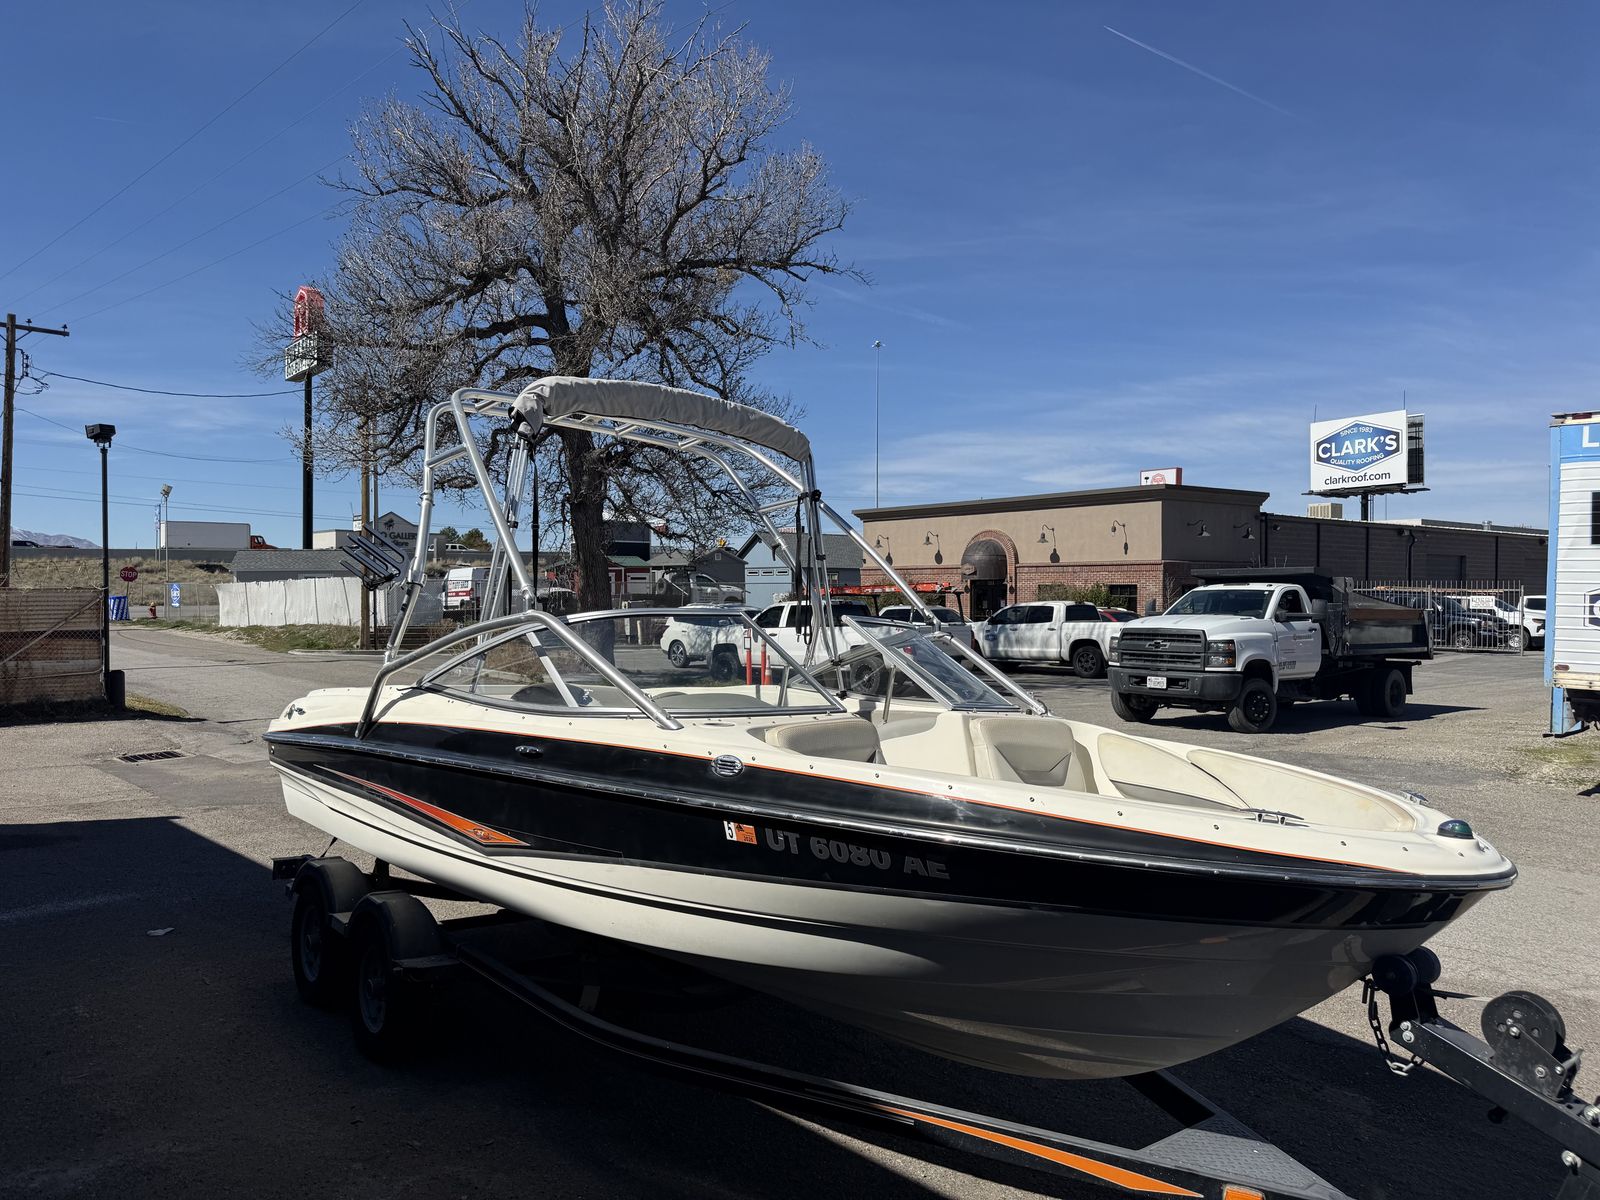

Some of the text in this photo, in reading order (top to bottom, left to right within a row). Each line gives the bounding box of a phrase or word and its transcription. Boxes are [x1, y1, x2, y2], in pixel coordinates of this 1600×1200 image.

[1340, 426, 1373, 437] SINCE 1983
[1318, 434, 1398, 459] CLARK'S
[1357, 452, 1385, 465] ROOFING
[1324, 472, 1391, 485] clarkroof.com
[389, 532, 417, 540] GALLER
[120, 570, 137, 578] STOP
[764, 828, 950, 879] UT 6080 AE
